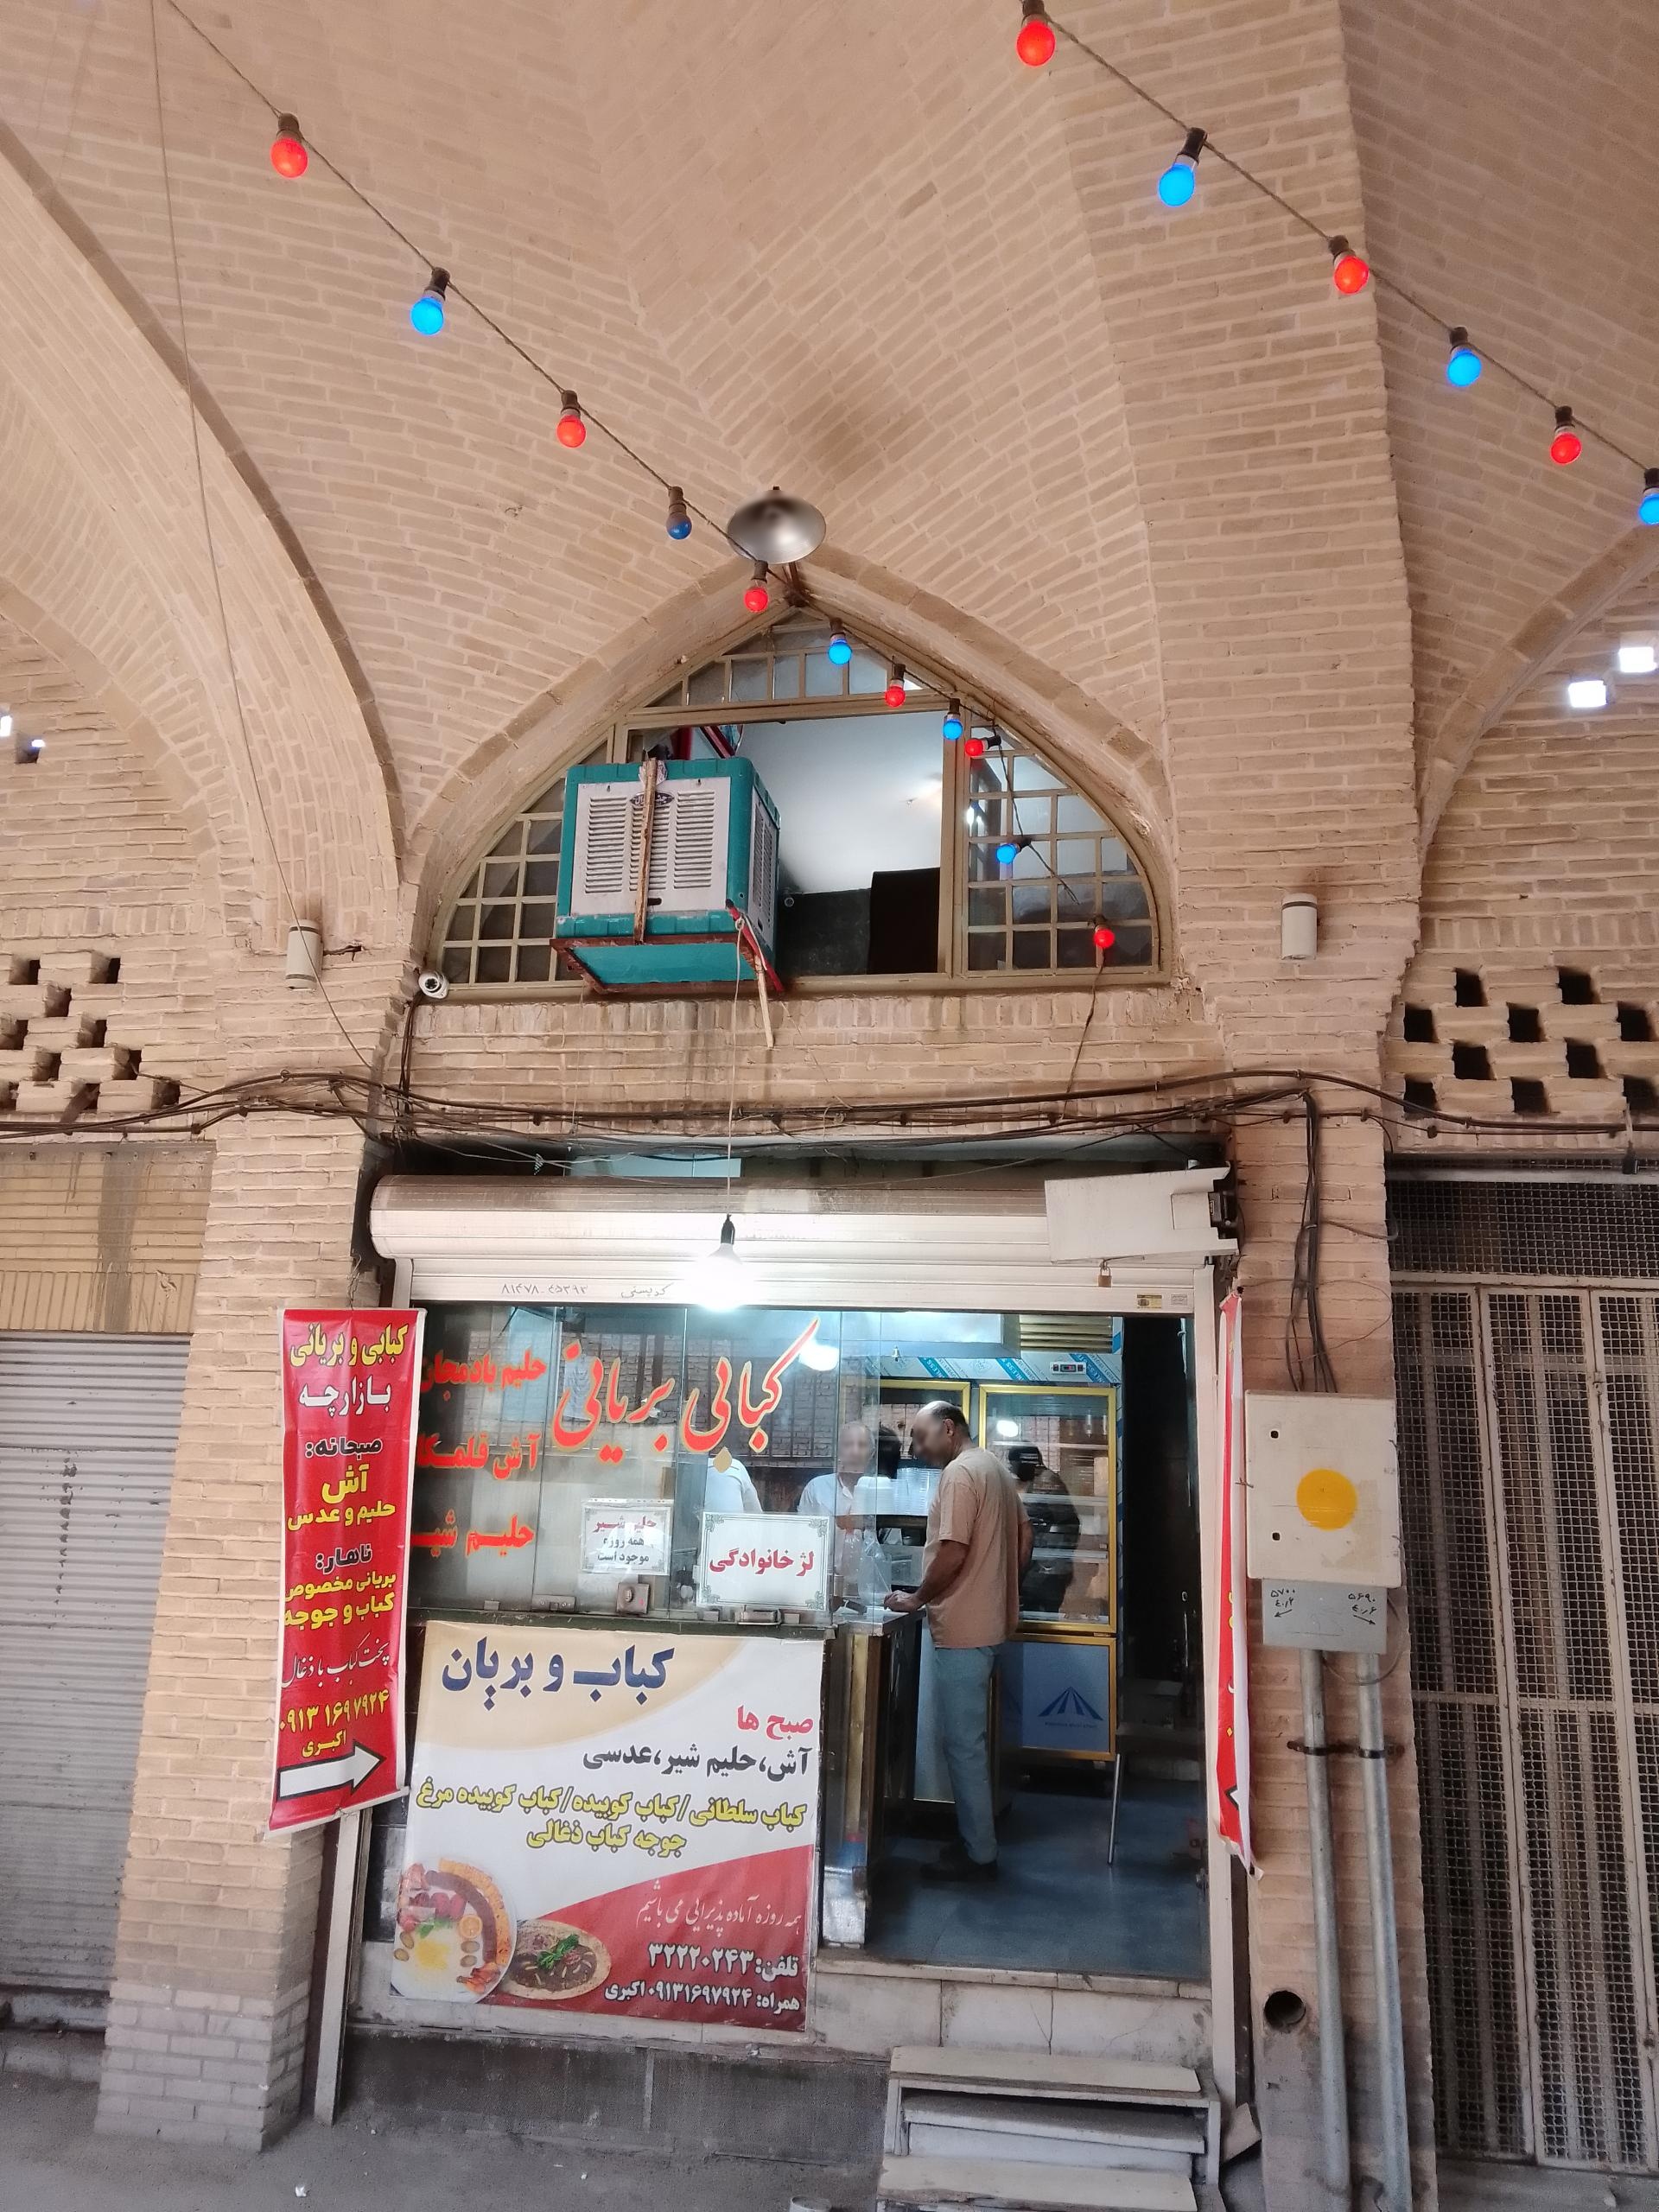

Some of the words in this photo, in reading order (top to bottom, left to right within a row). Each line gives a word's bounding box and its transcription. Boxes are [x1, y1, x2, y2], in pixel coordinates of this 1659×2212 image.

[289, 1323, 345, 1367] بریانی
[348, 1337, 358, 1366] و
[361, 1323, 409, 1366] کبابی
[500, 1346, 548, 1390] حلیم
[298, 1375, 391, 1418] بازارچه
[552, 1339, 676, 1465] بریانی
[681, 1317, 821, 1473] کبابی
[305, 1436, 383, 1461] صبحانه:
[416, 1432, 490, 1470] قلمکا
[493, 1433, 542, 1480] آش
[321, 1463, 370, 1504] آش
[288, 1508, 340, 1531] عدس
[344, 1507, 354, 1527] و
[356, 1500, 396, 1526] حلیم
[592, 1514, 626, 1534] شیر
[410, 1509, 459, 1558] شی
[466, 1514, 536, 1559] حلیم
[628, 1537, 645, 1547] همه
[315, 1543, 372, 1574] ناهار:
[597, 1551, 618, 1562] است
[619, 1554, 650, 1566] موجود
[709, 1548, 794, 1575] خانوادگی
[796, 1550, 815, 1577] لژ
[284, 1575, 353, 1602] مخصوص
[356, 1571, 397, 1592] بریانی
[284, 1607, 339, 1630] جوجه
[342, 1604, 353, 1625] و
[355, 1592, 396, 1620] کباب
[327, 1632, 371, 1686] کباب
[359, 1638, 391, 1666] پخت
[281, 1654, 315, 1688] ذغال
[317, 1656, 325, 1688] با
[442, 1637, 534, 1711] بریان
[543, 1654, 564, 1692] و
[573, 1644, 675, 1706] کباب
[736, 1705, 760, 1731] ها
[766, 1713, 814, 1740] صبح
[302, 1728, 346, 1758] اکبری
[416, 1776, 454, 1809] مرغ
[456, 1783, 517, 1813] کوبیده
[526, 1818, 583, 1848] ذغالی
[760, 1802, 808, 1834] کباب
[586, 1822, 632, 1853] کباب
[633, 1829, 688, 1858] جوجه
[636, 1880, 663, 1929] باشیم
[665, 1898, 684, 1924] می
[685, 1897, 724, 1937] پذیرایی
[726, 1894, 760, 1923] آماده
[755, 1904, 784, 1926] روزه
[785, 1913, 802, 1936] همه
[605, 1980, 646, 2002] اکبری
